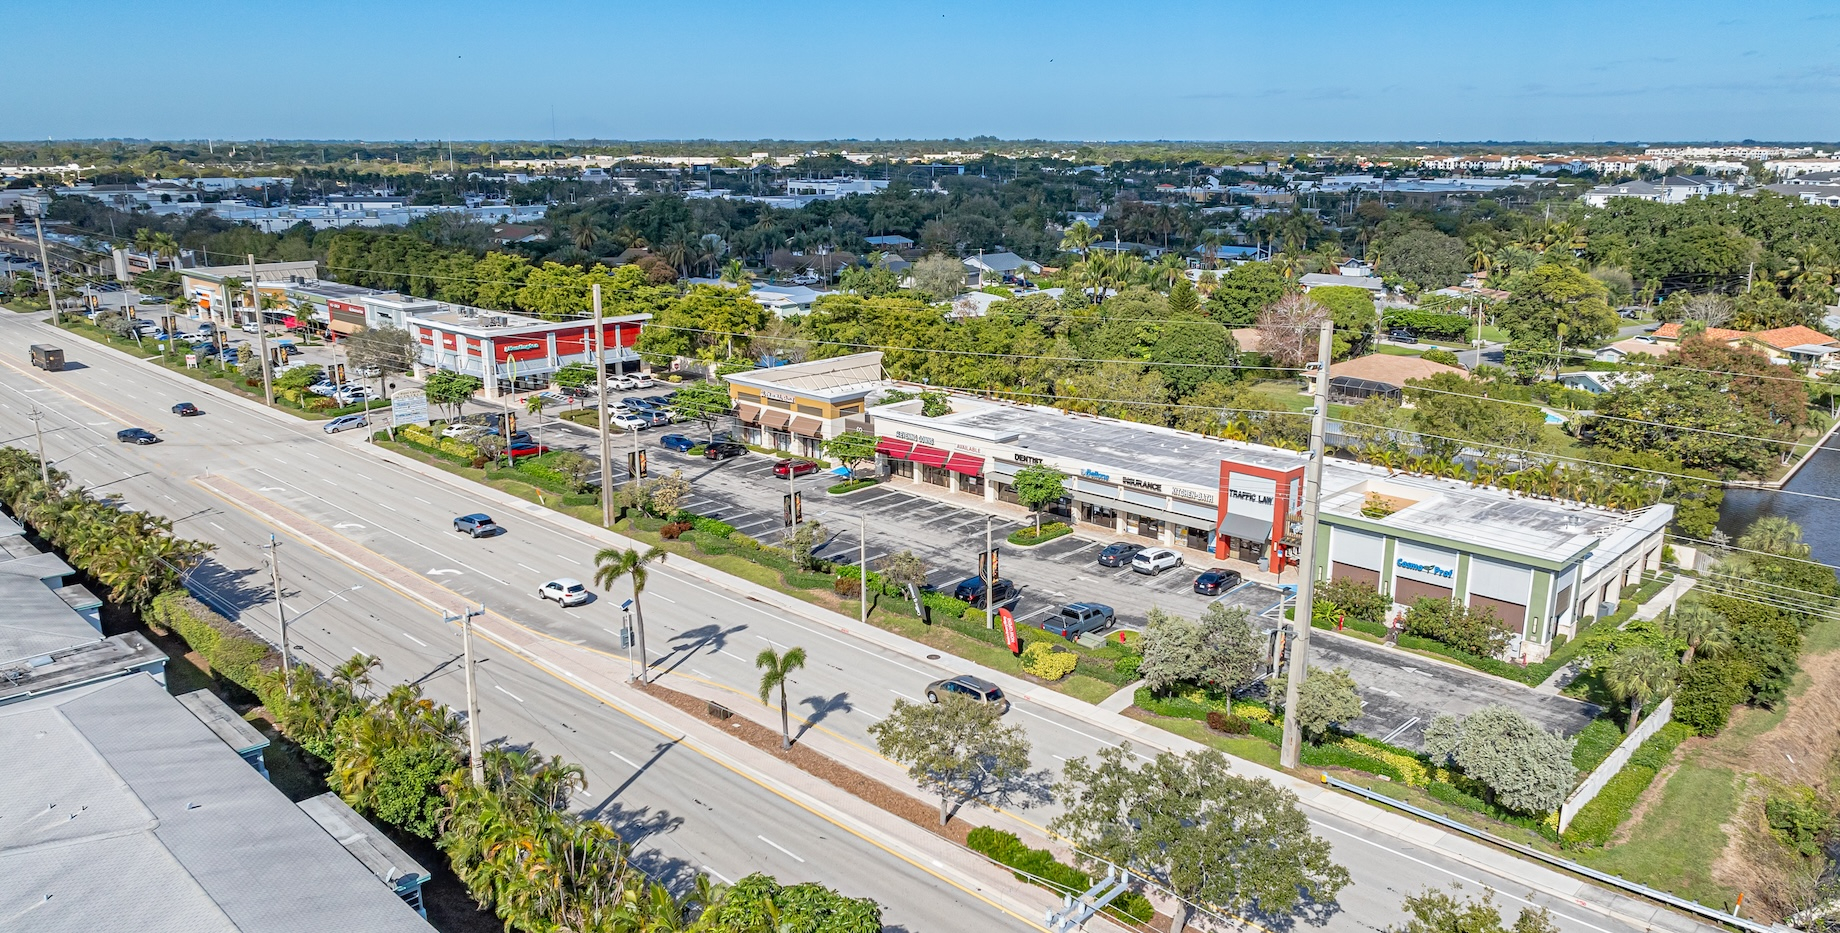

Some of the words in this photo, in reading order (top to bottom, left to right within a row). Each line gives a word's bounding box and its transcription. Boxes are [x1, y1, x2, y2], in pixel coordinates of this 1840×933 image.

[956, 443, 981, 453] AVAILABLE
[1014, 453, 1043, 464] DENTIST
[1122, 477, 1162, 492] INSURANCE
[1229, 489, 1256, 502] TRAFFIC
[1258, 495, 1274, 506] LAW
[1397, 558, 1423, 571] Cosmo
[1434, 566, 1453, 578] Prof
